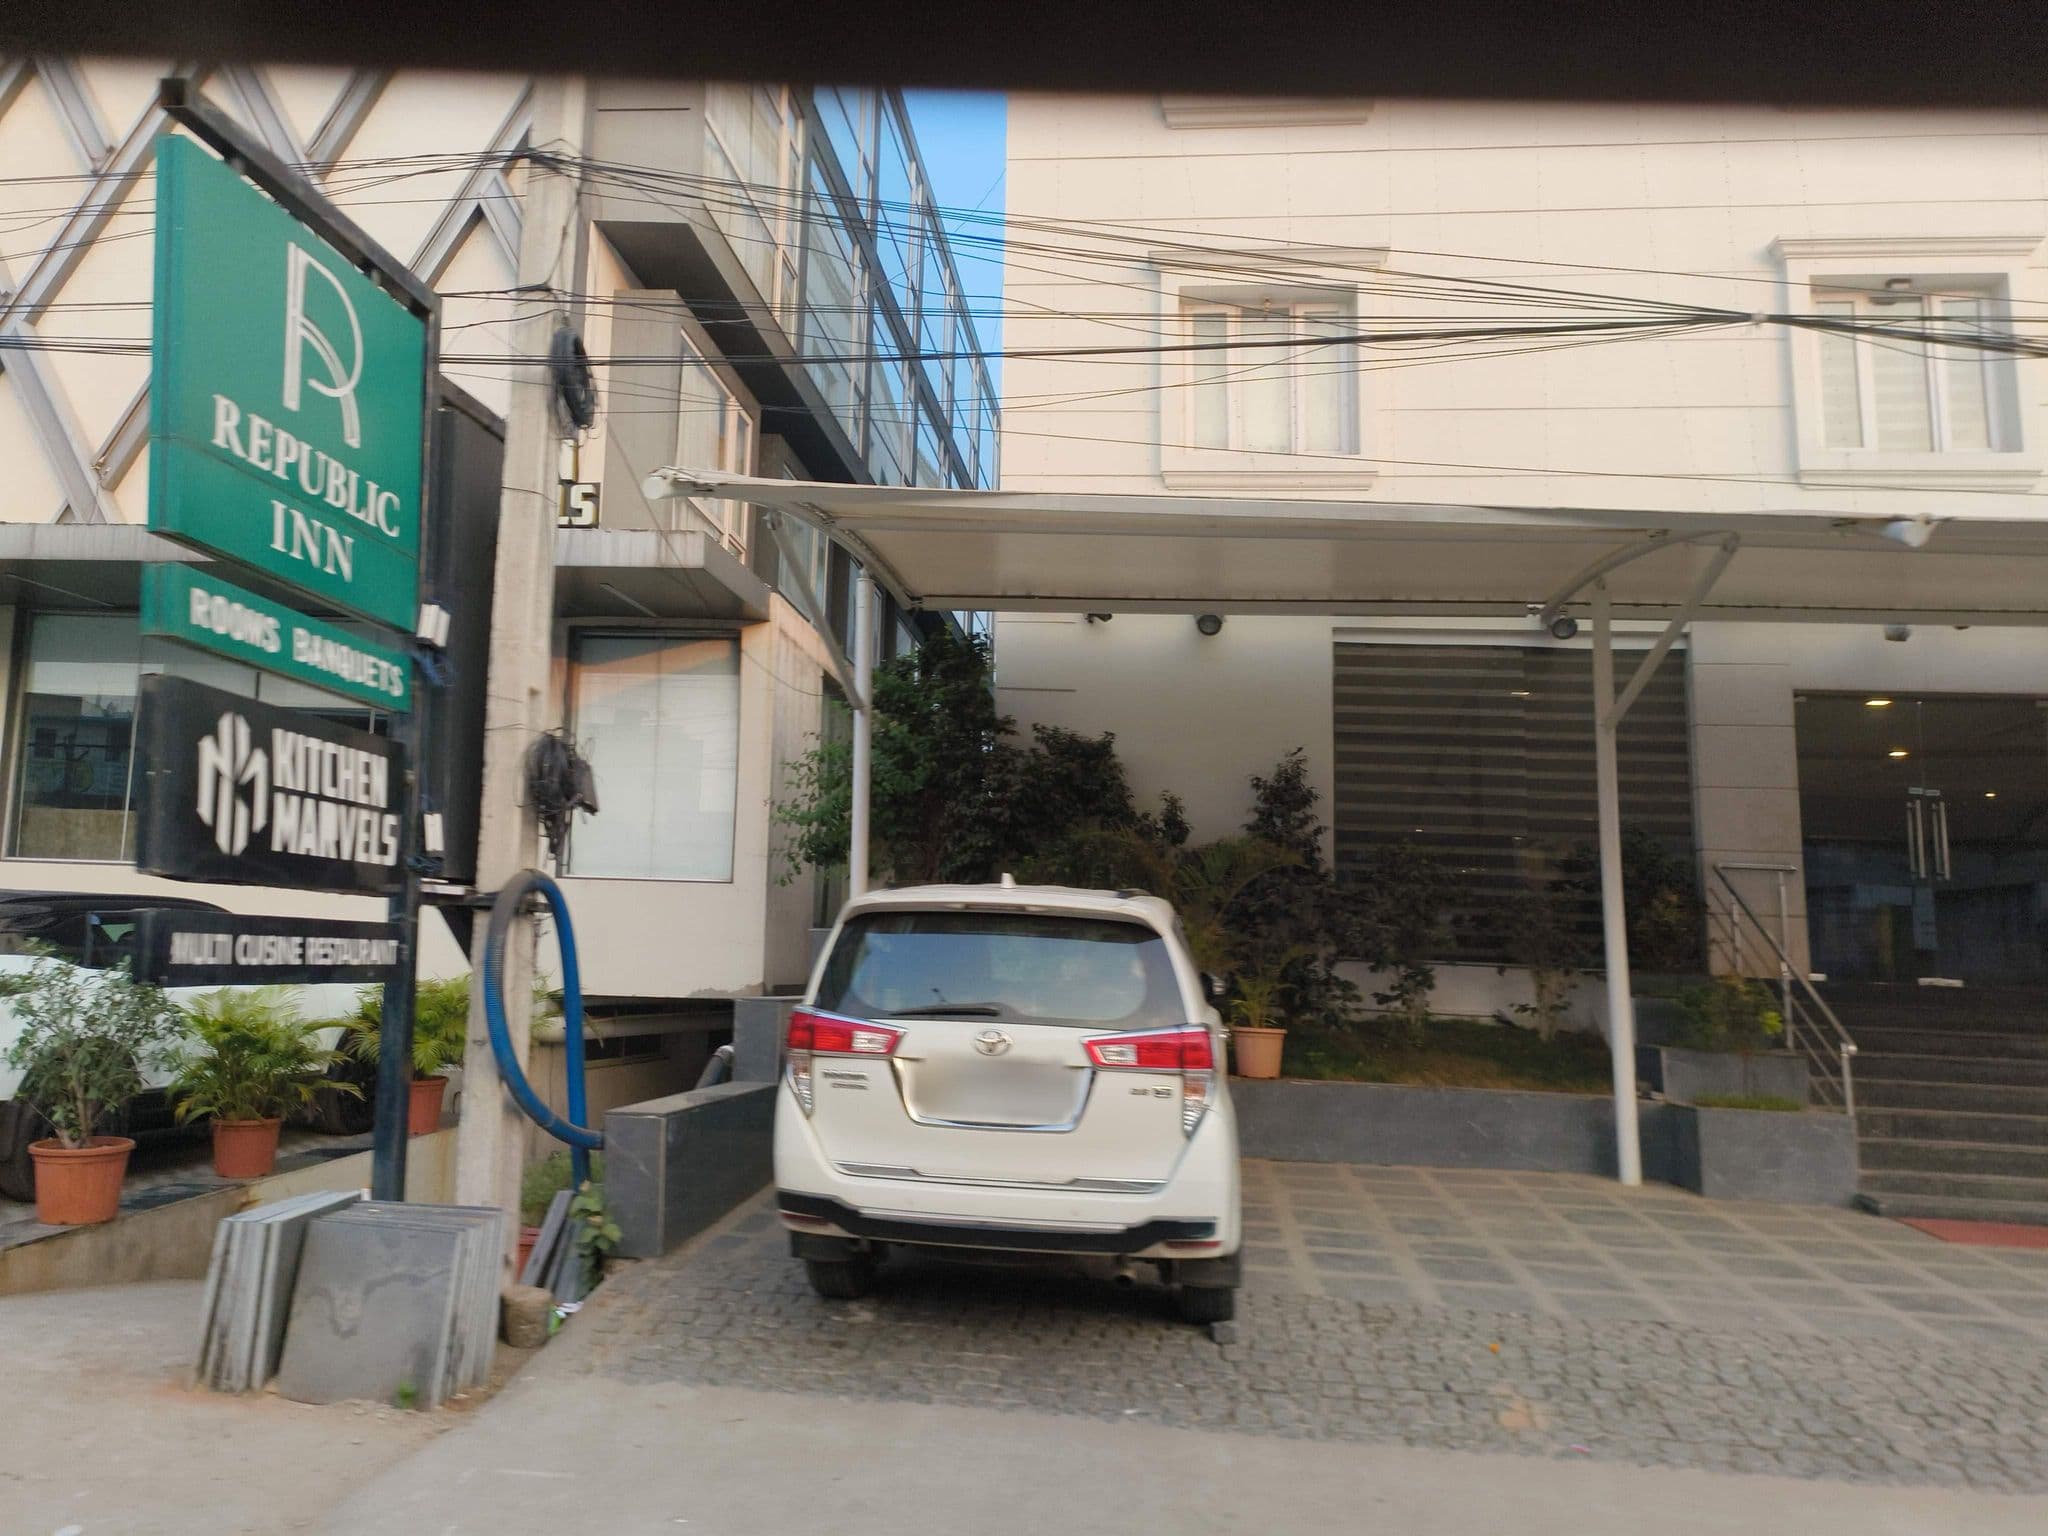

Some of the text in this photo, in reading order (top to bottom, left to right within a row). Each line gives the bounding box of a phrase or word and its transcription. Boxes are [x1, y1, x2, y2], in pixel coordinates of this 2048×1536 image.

[211, 394, 400, 537] REPUBLIC
[270, 500, 354, 582] INN
[190, 587, 403, 697] ROOMS BANQUETS
[272, 728, 388, 808] KITCHEN
[271, 792, 398, 866] MARVELS
